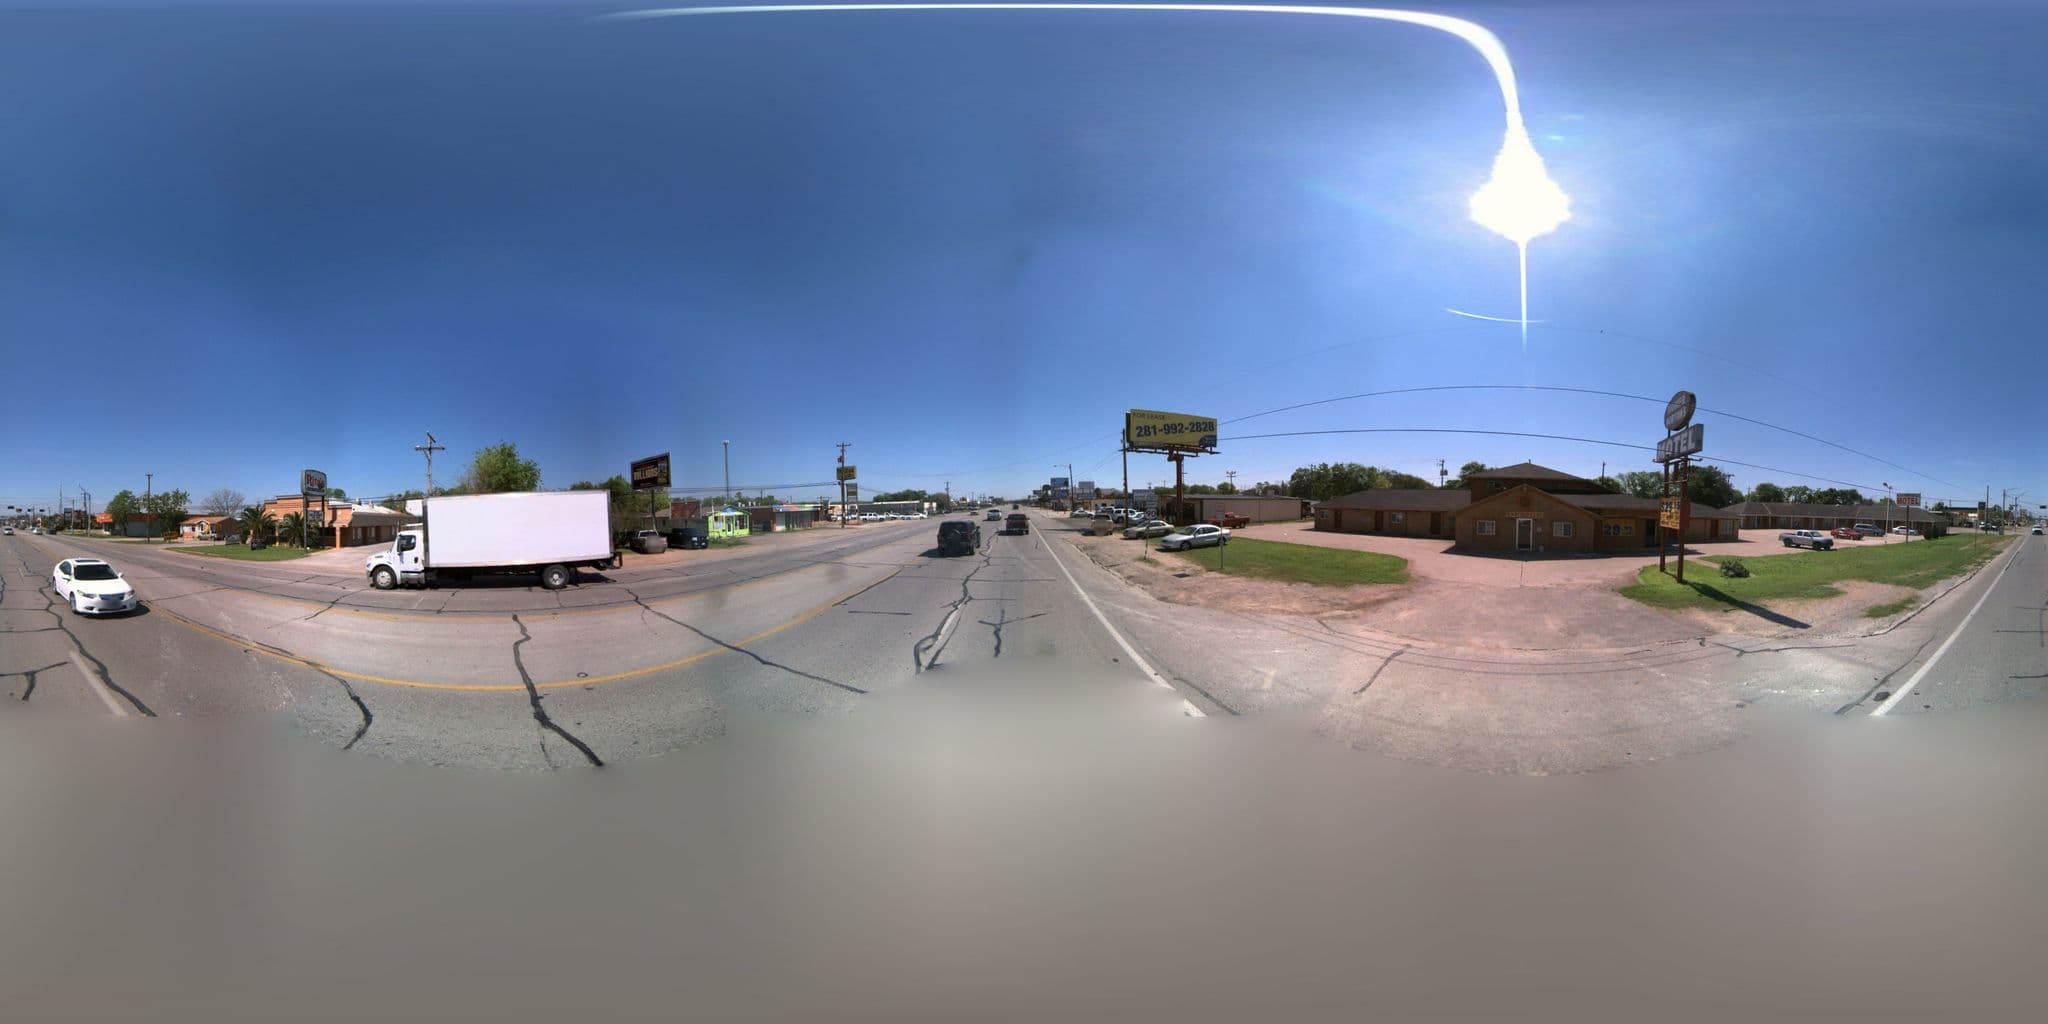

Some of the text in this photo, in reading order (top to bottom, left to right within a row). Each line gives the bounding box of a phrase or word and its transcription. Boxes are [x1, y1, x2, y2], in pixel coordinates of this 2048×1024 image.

[1136, 421, 1214, 437] 281-992-2828
[1657, 428, 1697, 462] MOTEL
[1897, 496, 1920, 505] MOTEL
